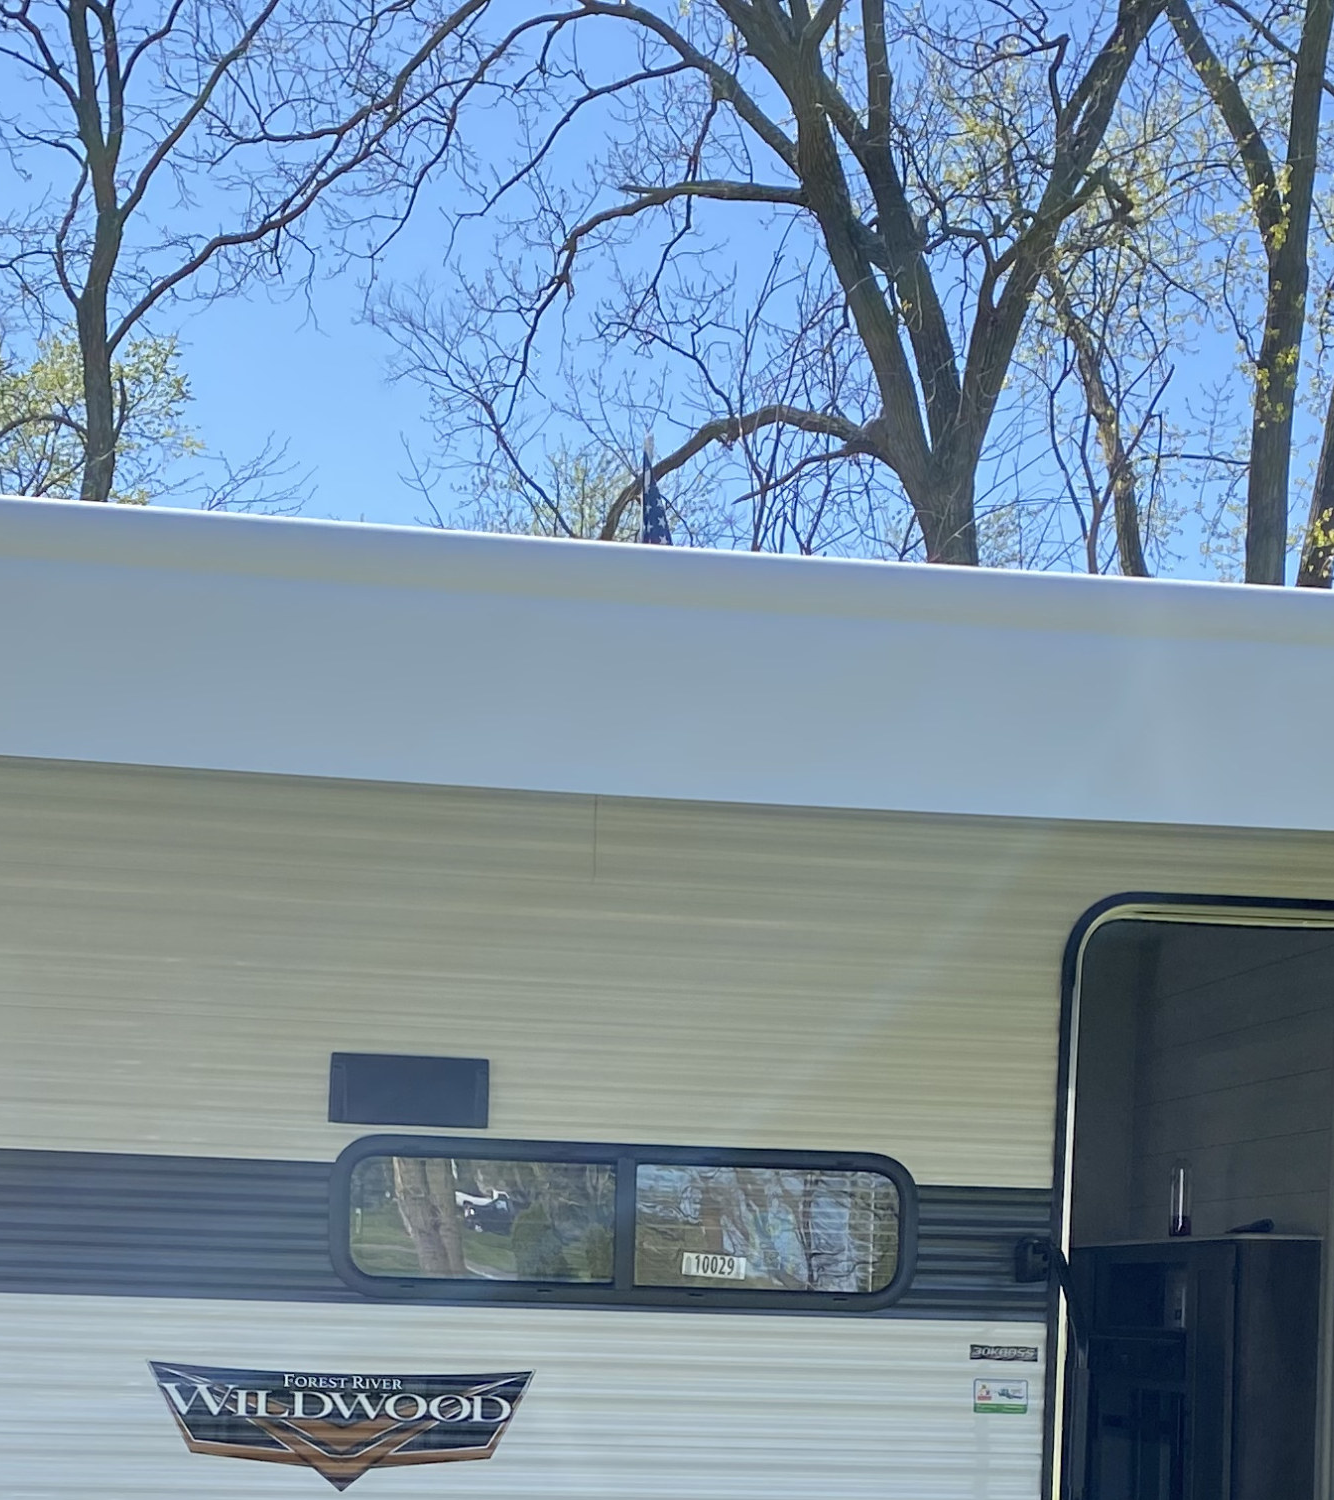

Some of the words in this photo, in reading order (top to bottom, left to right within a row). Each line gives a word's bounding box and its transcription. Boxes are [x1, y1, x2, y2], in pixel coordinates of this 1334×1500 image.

[695, 1255, 735, 1275] 10029
[283, 1373, 348, 1389] FOREST
[351, 1375, 403, 1390] RIVER
[163, 1382, 512, 1422] WILDWOOD
